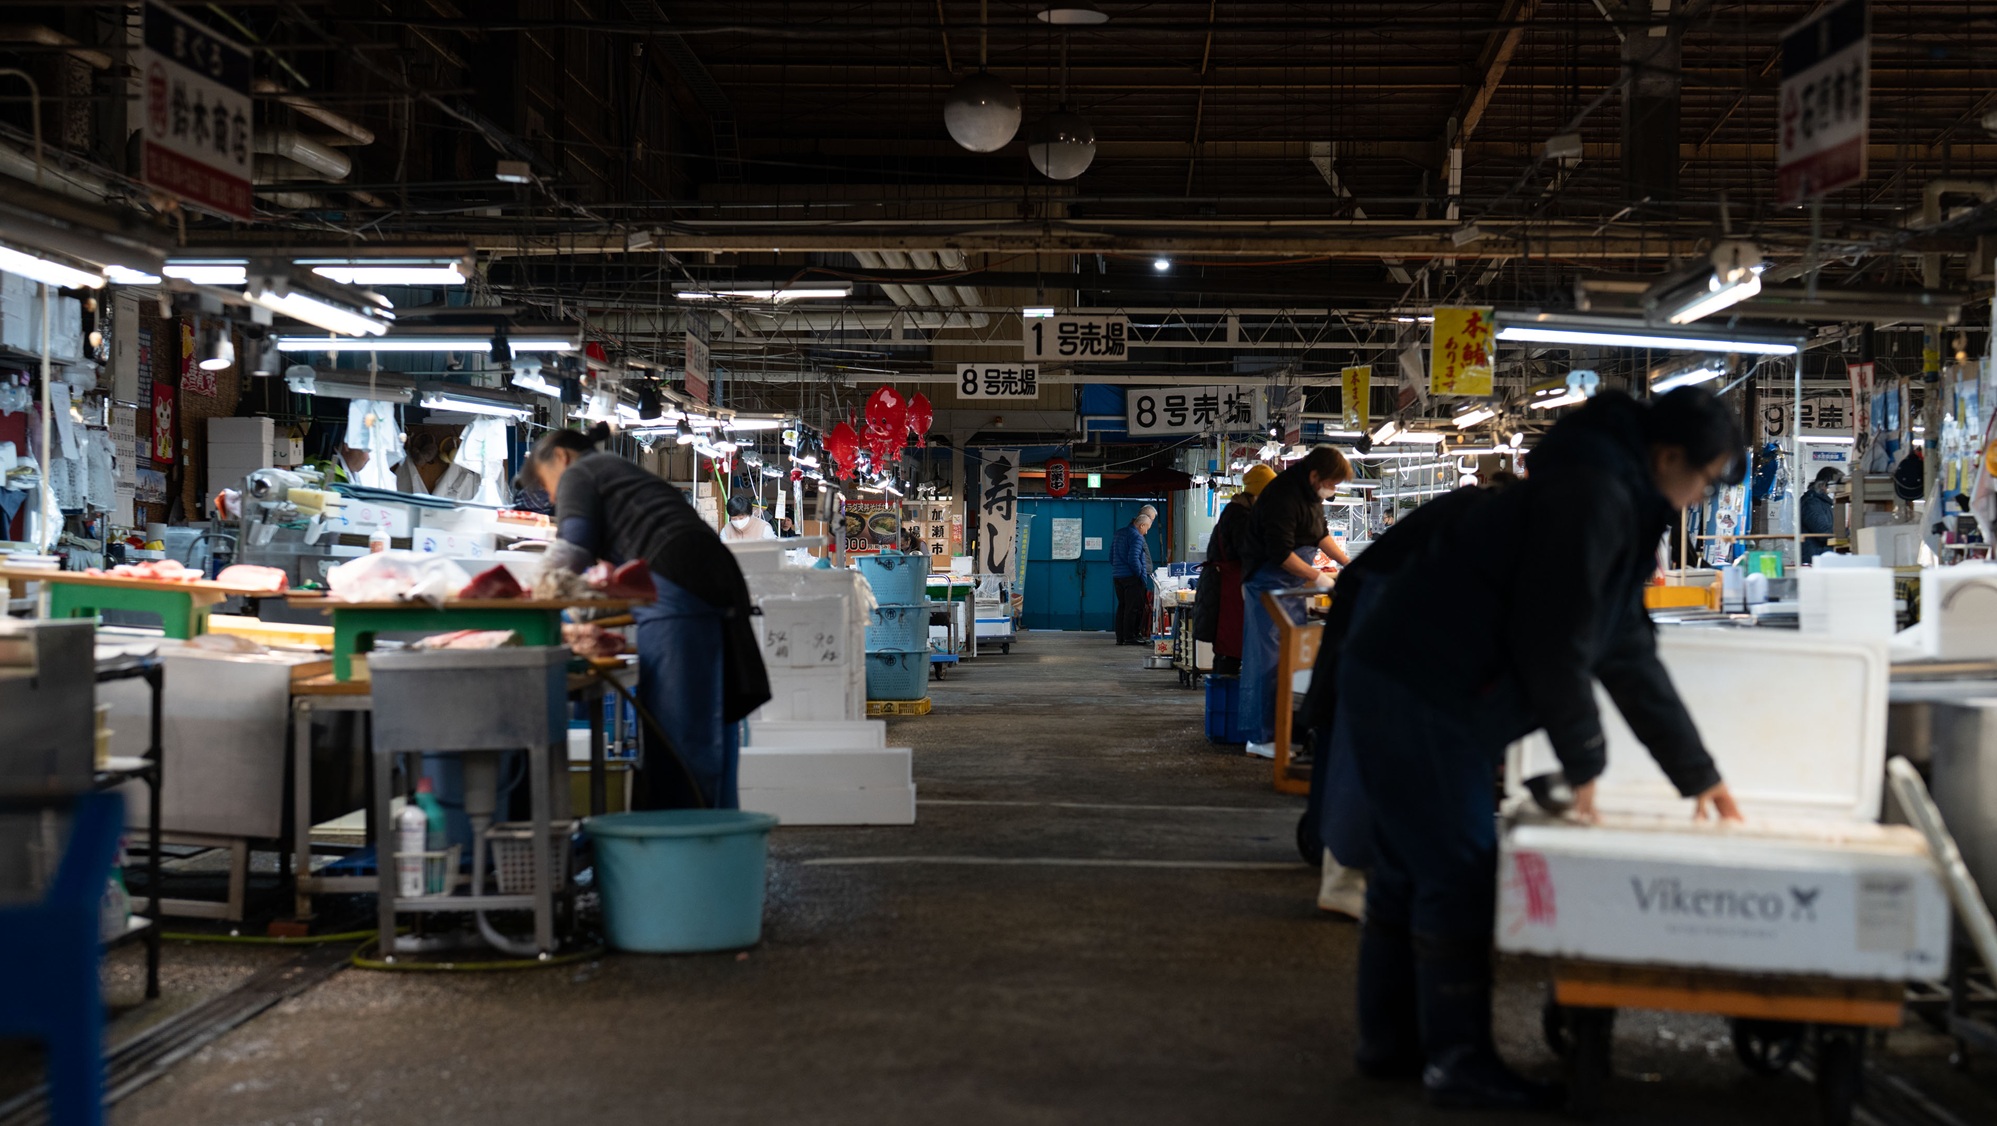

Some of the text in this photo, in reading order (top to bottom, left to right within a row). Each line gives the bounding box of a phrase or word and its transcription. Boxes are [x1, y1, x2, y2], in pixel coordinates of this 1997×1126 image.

[1032, 322, 1126, 356] 1号売場
[961, 369, 1036, 395] 8号売場
[1136, 393, 1251, 428] 8号売場
[931, 508, 944, 555] 加瀬市
[983, 455, 1017, 574] 寿し
[1630, 876, 1784, 921] Vikenco
